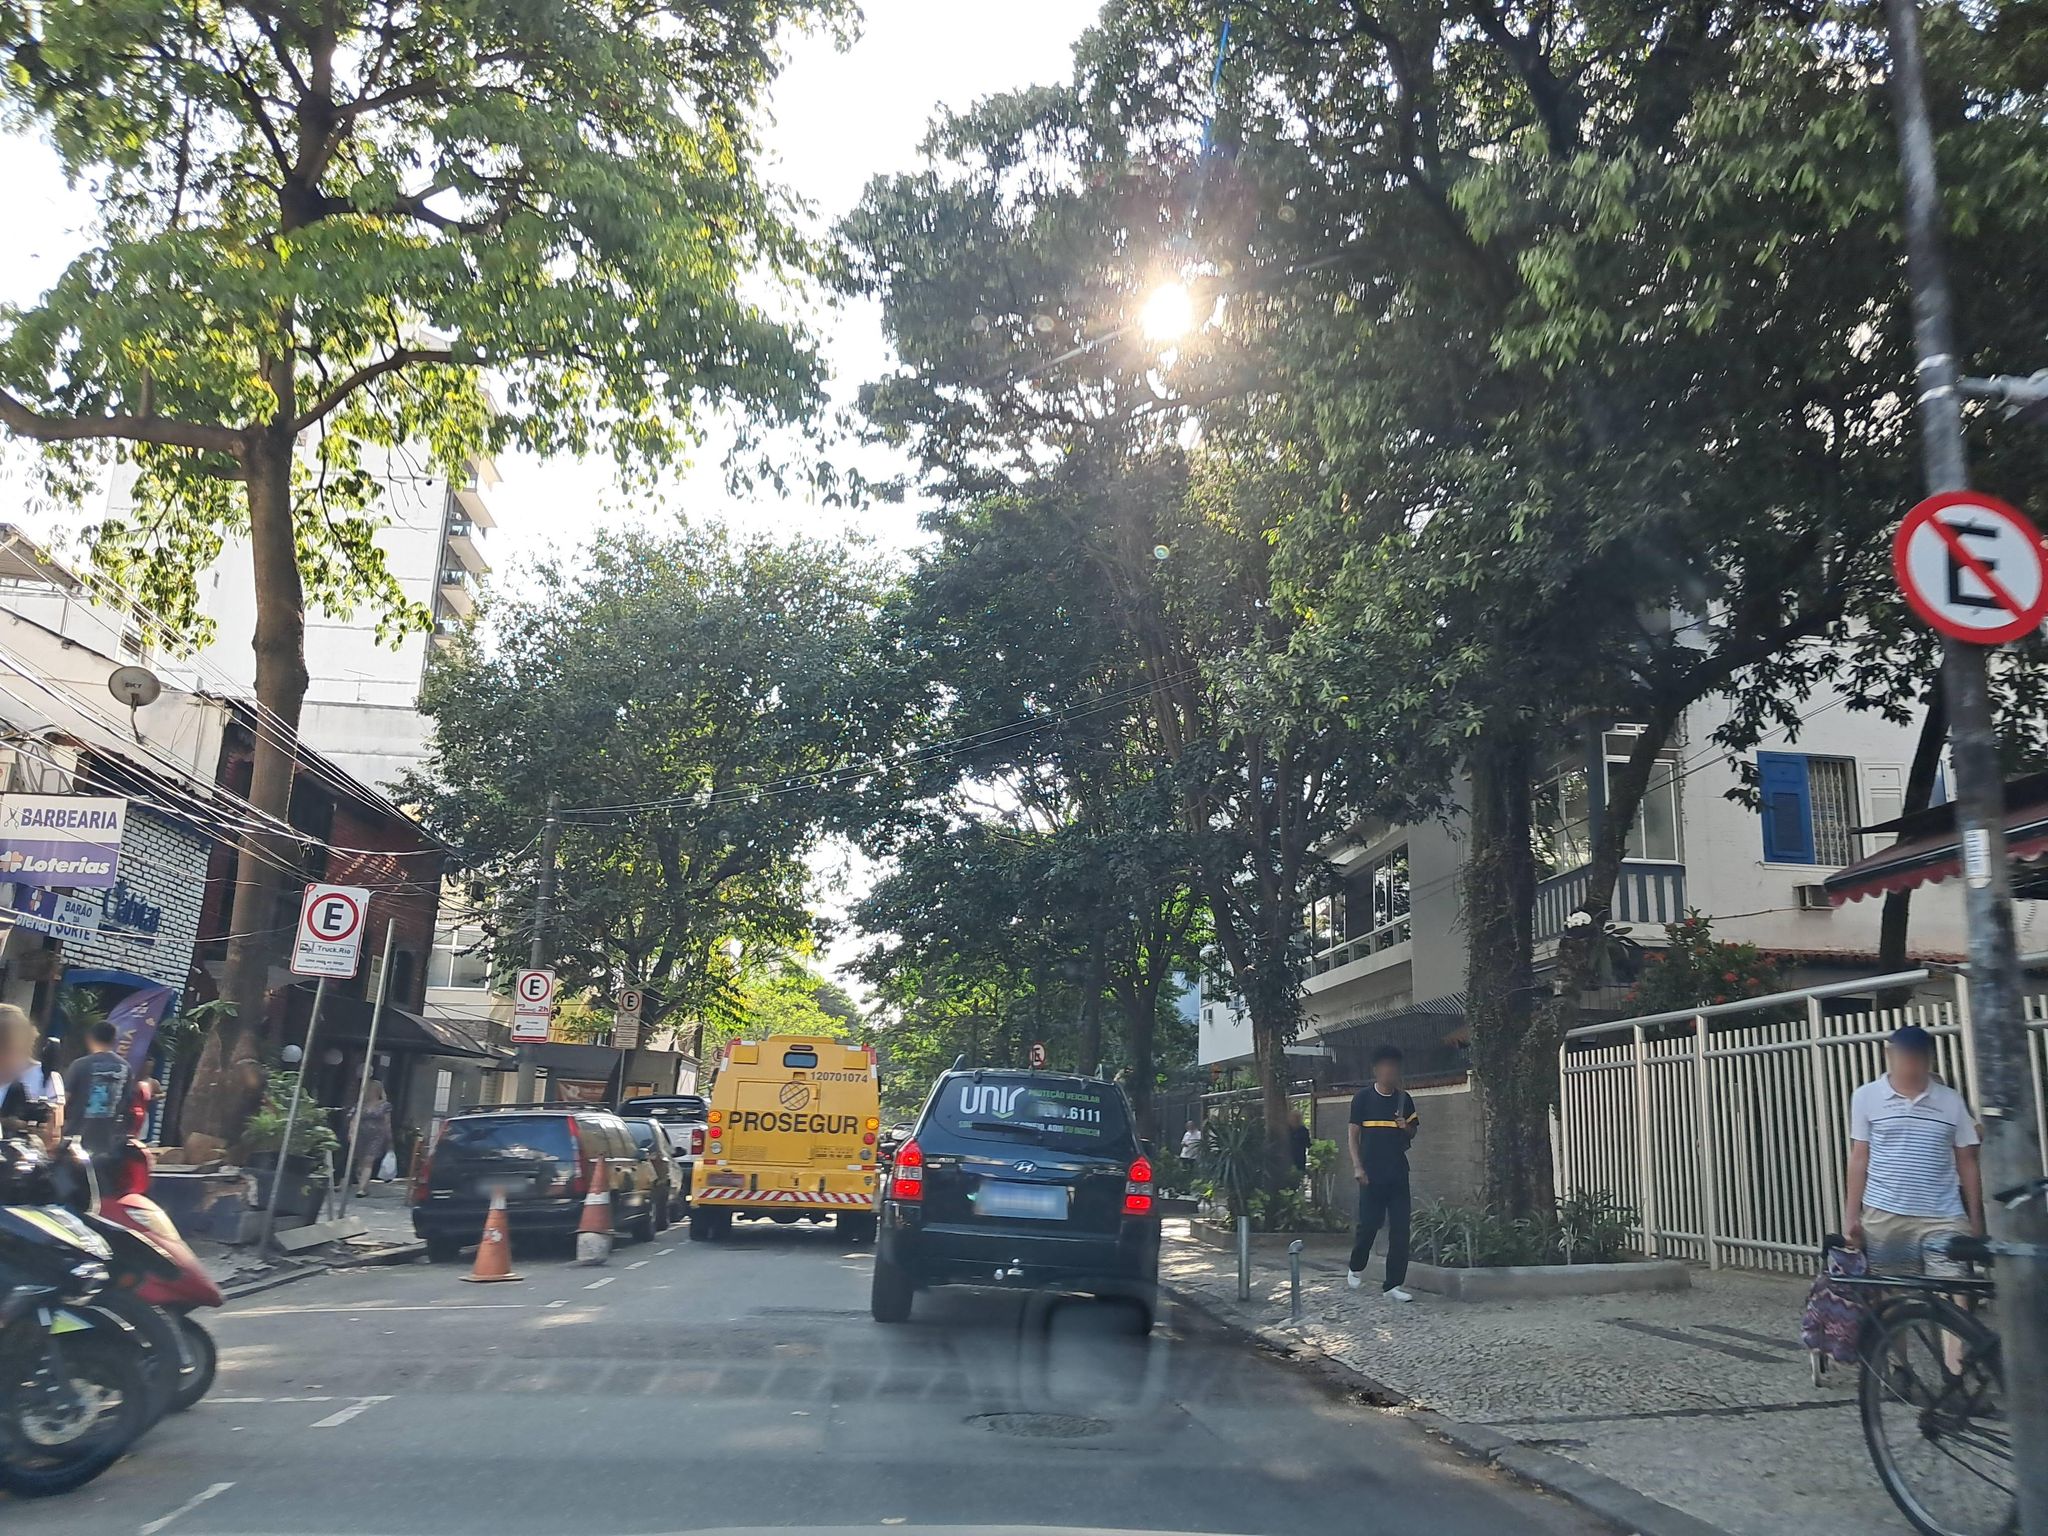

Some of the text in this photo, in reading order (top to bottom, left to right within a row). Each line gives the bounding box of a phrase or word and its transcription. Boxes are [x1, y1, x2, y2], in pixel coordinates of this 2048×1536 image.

[1946, 522, 2008, 610] E
[20, 808, 118, 830] BARBEARIA
[22, 856, 110, 875] Loterias
[323, 902, 344, 931] E
[529, 979, 541, 996] E
[627, 995, 635, 1008] E
[810, 1071, 869, 1083] 120701074
[728, 1111, 859, 1135] PROSEGUR
